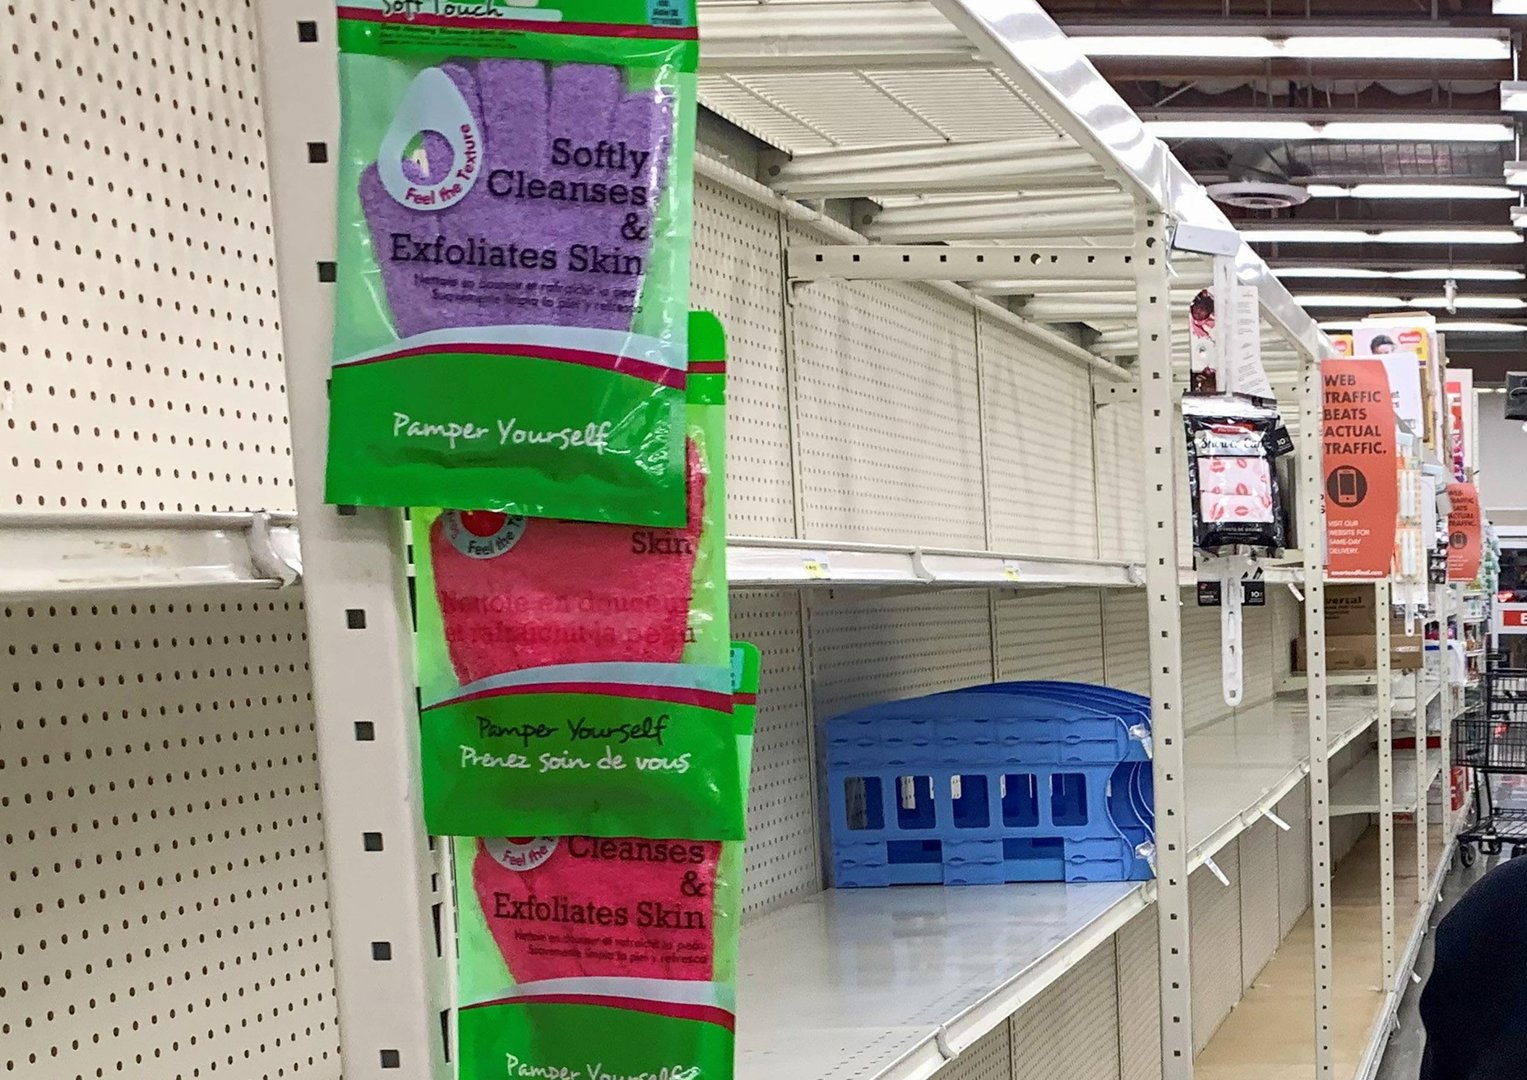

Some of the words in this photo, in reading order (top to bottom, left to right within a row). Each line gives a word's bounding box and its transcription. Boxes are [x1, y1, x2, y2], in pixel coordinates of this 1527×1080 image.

[405, 187, 435, 205] Feel
[439, 182, 462, 203] the
[456, 123, 478, 182] Texture
[552, 138, 650, 178] Softly
[488, 169, 647, 206] Cleanses
[620, 212, 646, 241] &
[390, 233, 558, 270] Exfoliates
[568, 244, 645, 275] Skin
[1325, 374, 1356, 386] WEB
[1325, 391, 1381, 404] TRAFFIC
[1324, 408, 1367, 420] BEATS
[393, 412, 489, 449] Pamper
[497, 418, 612, 455] Yourself
[1324, 425, 1382, 437] ACTUAL
[1325, 441, 1387, 454] TRAFFIC.
[467, 540, 495, 556] Feel
[497, 530, 515, 551] the
[631, 531, 693, 555] Skin
[476, 715, 559, 747] Pamper
[567, 714, 671, 746] Yourself
[460, 745, 532, 769] Prenez
[538, 750, 592, 773] soin
[596, 746, 627, 770] de
[636, 752, 692, 774] vous
[502, 850, 526, 866] Feel
[529, 844, 548, 862] the
[567, 836, 706, 865] Cleanses
[680, 871, 707, 897] &
[493, 891, 629, 926] Exfoliates
[637, 901, 706, 930] Skin
